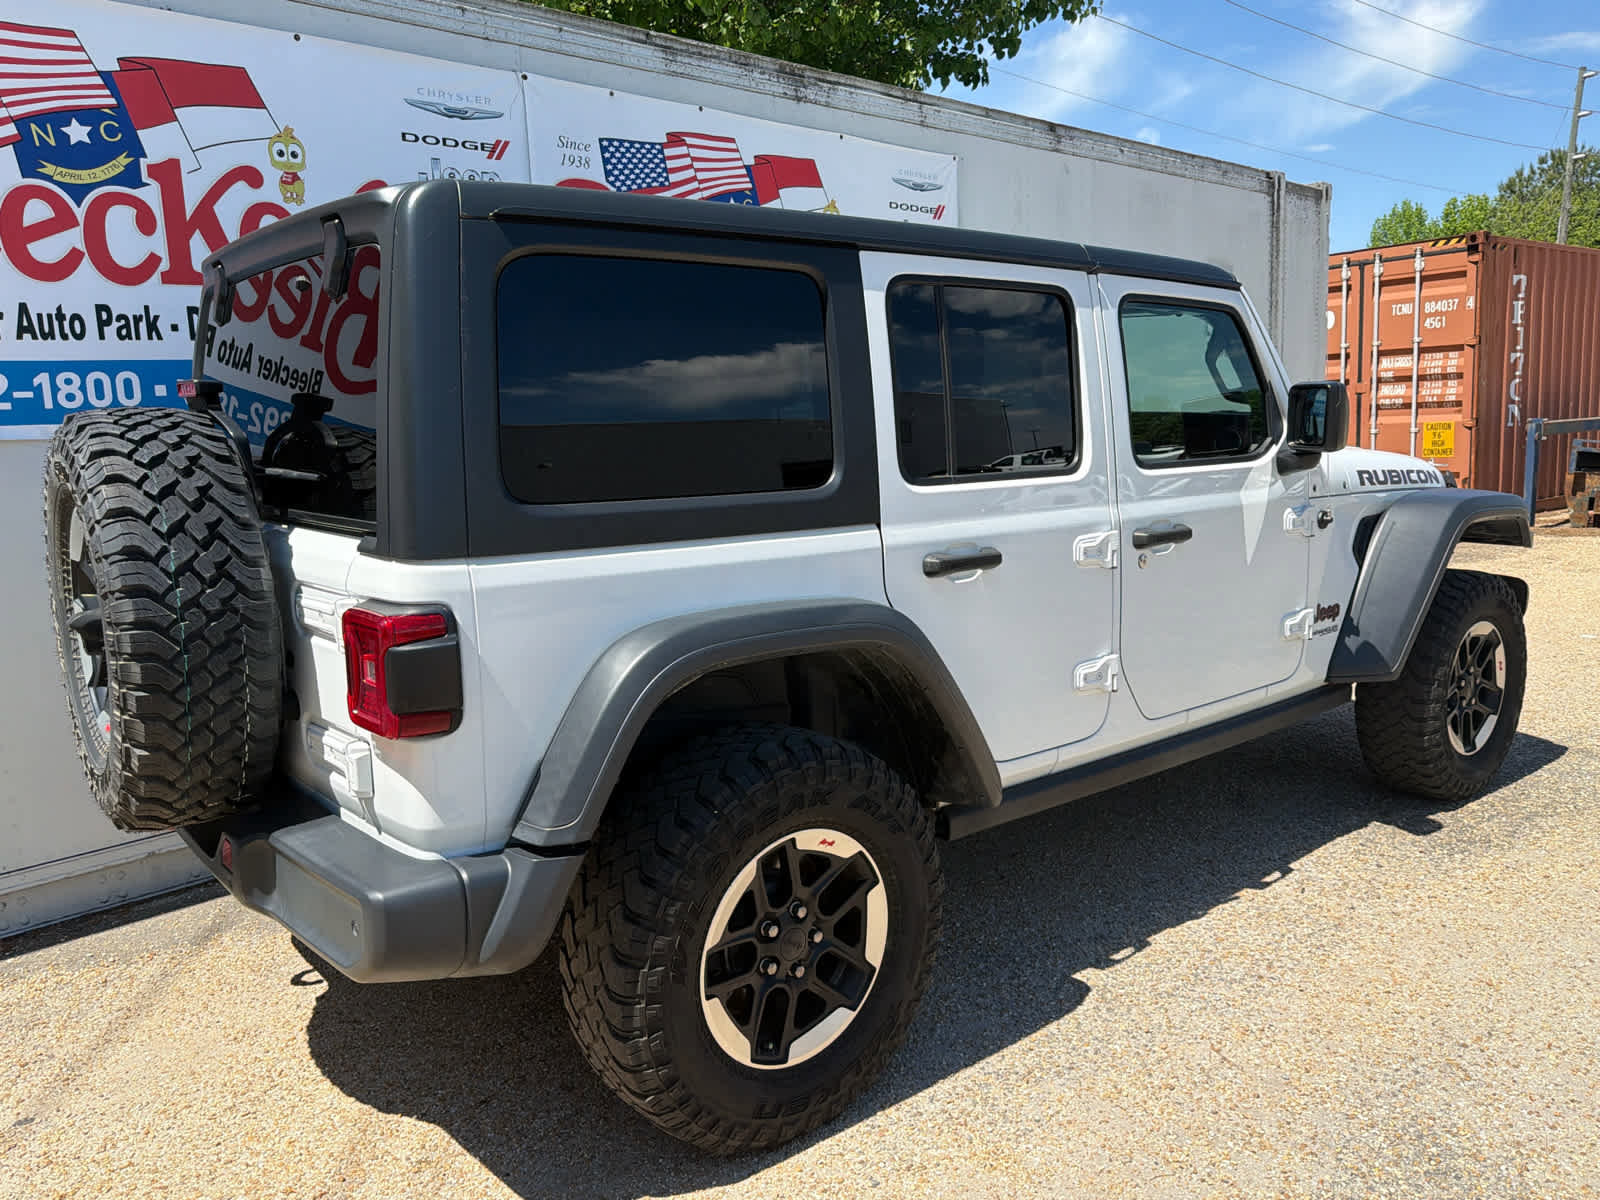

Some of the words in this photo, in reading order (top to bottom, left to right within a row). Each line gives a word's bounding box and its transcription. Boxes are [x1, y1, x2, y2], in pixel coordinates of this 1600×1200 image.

[416, 87, 492, 105] CHRYSLER
[30, 122, 56, 147] N
[99, 120, 123, 142] C
[400, 131, 498, 153] DODGE
[556, 135, 592, 153] Since
[560, 153, 592, 169] 1938
[55, 170, 84, 181] APRIL
[102, 162, 121, 176] 1776
[888, 201, 938, 215] DODGE
[1391, 303, 1413, 316] TCNU
[1424, 298, 1459, 313] 884037
[16, 302, 86, 341] Auto
[95, 303, 163, 341] Park
[1424, 315, 1446, 329] 45G1
[1426, 422, 1452, 431] CAUTION
[1423, 447, 1453, 456] CONTAINER
[1356, 469, 1441, 487] RUBICON
[1315, 603, 1340, 622] Jeep
